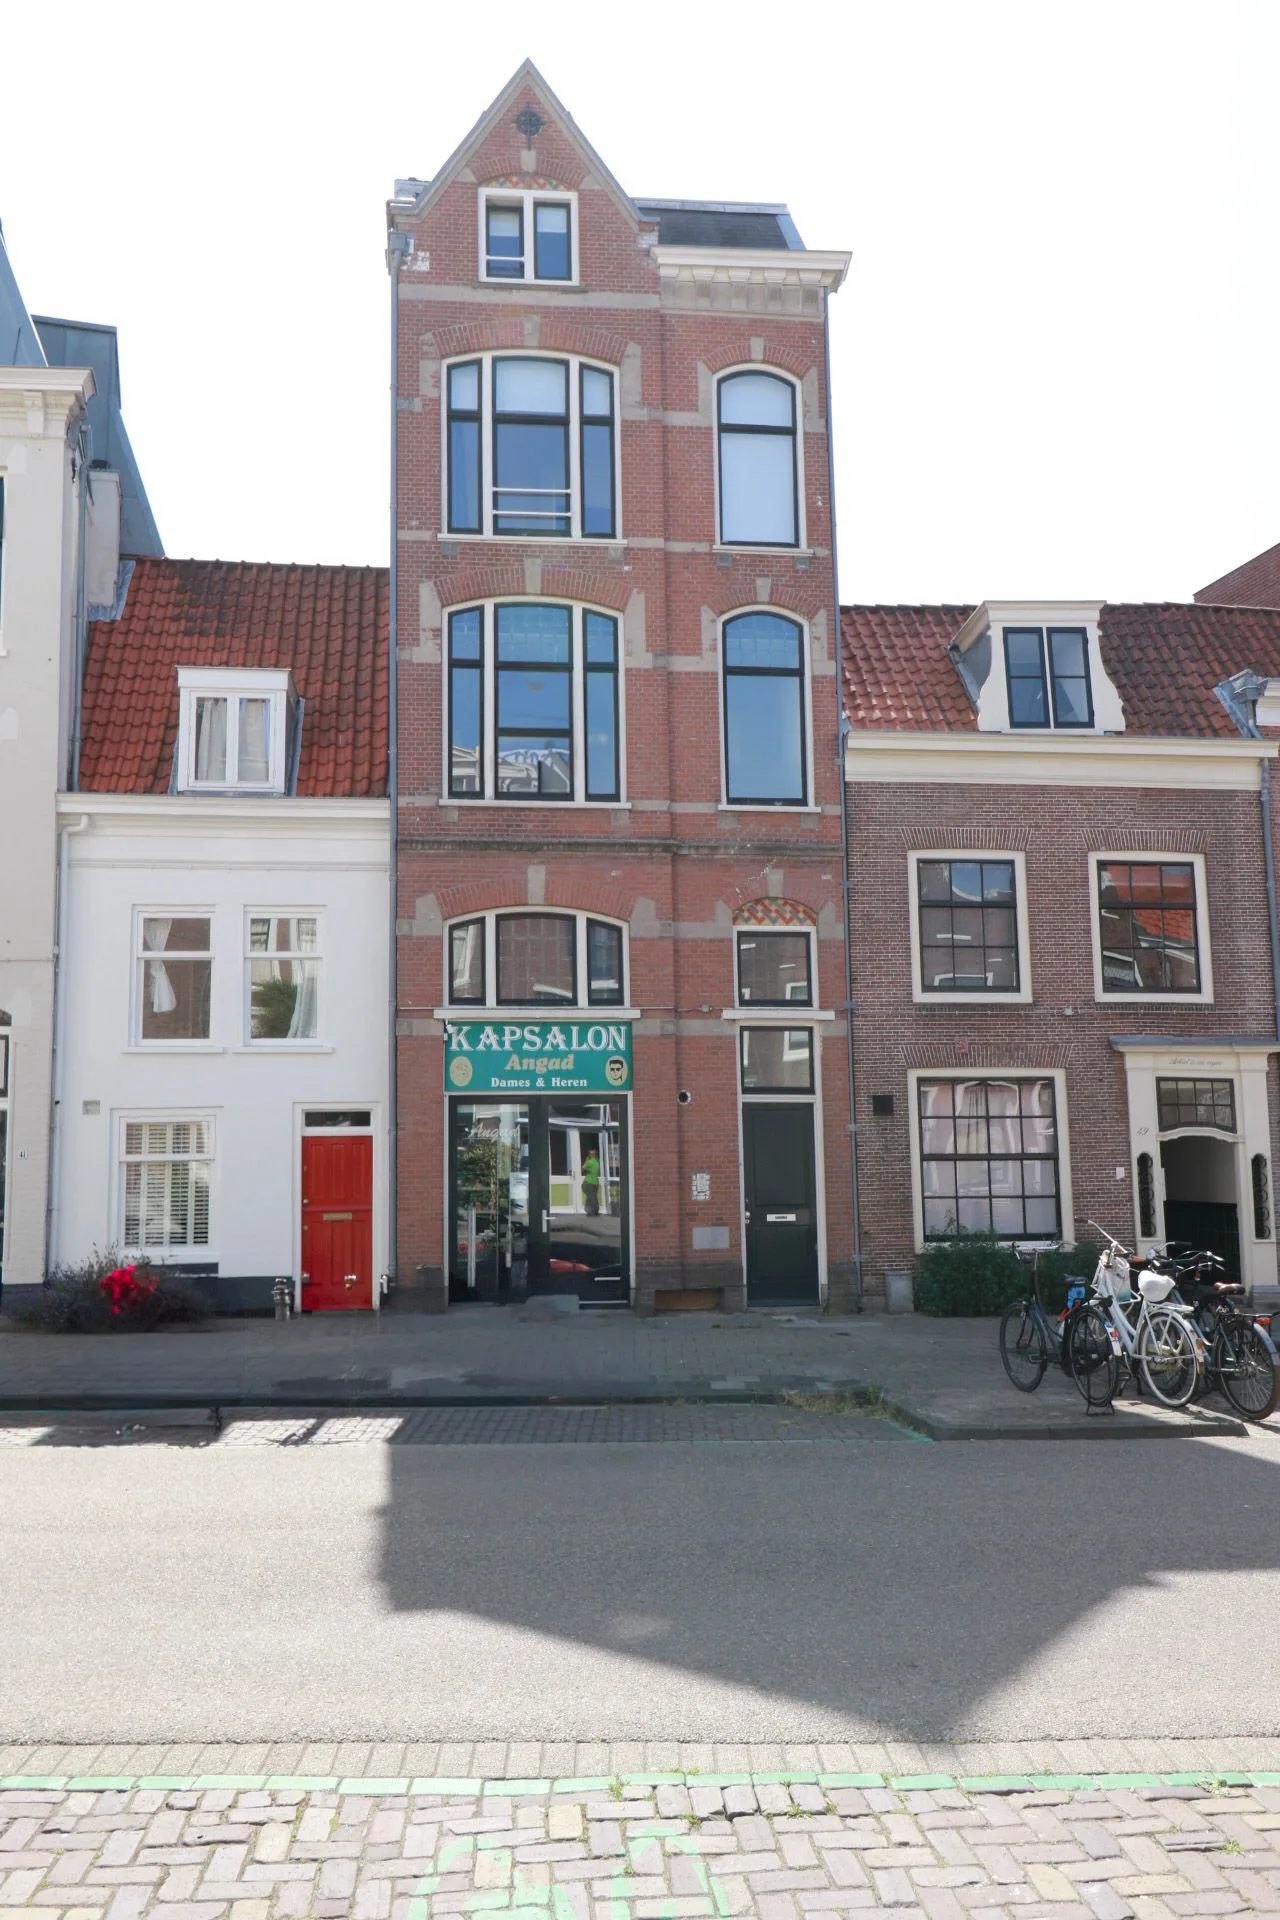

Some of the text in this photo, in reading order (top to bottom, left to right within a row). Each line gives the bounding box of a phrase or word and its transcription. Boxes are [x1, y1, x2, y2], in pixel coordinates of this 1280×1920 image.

[451, 1026, 627, 1051] KAPSALON
[505, 1053, 574, 1073] Angad
[491, 1077, 588, 1088] Dames & Heren
